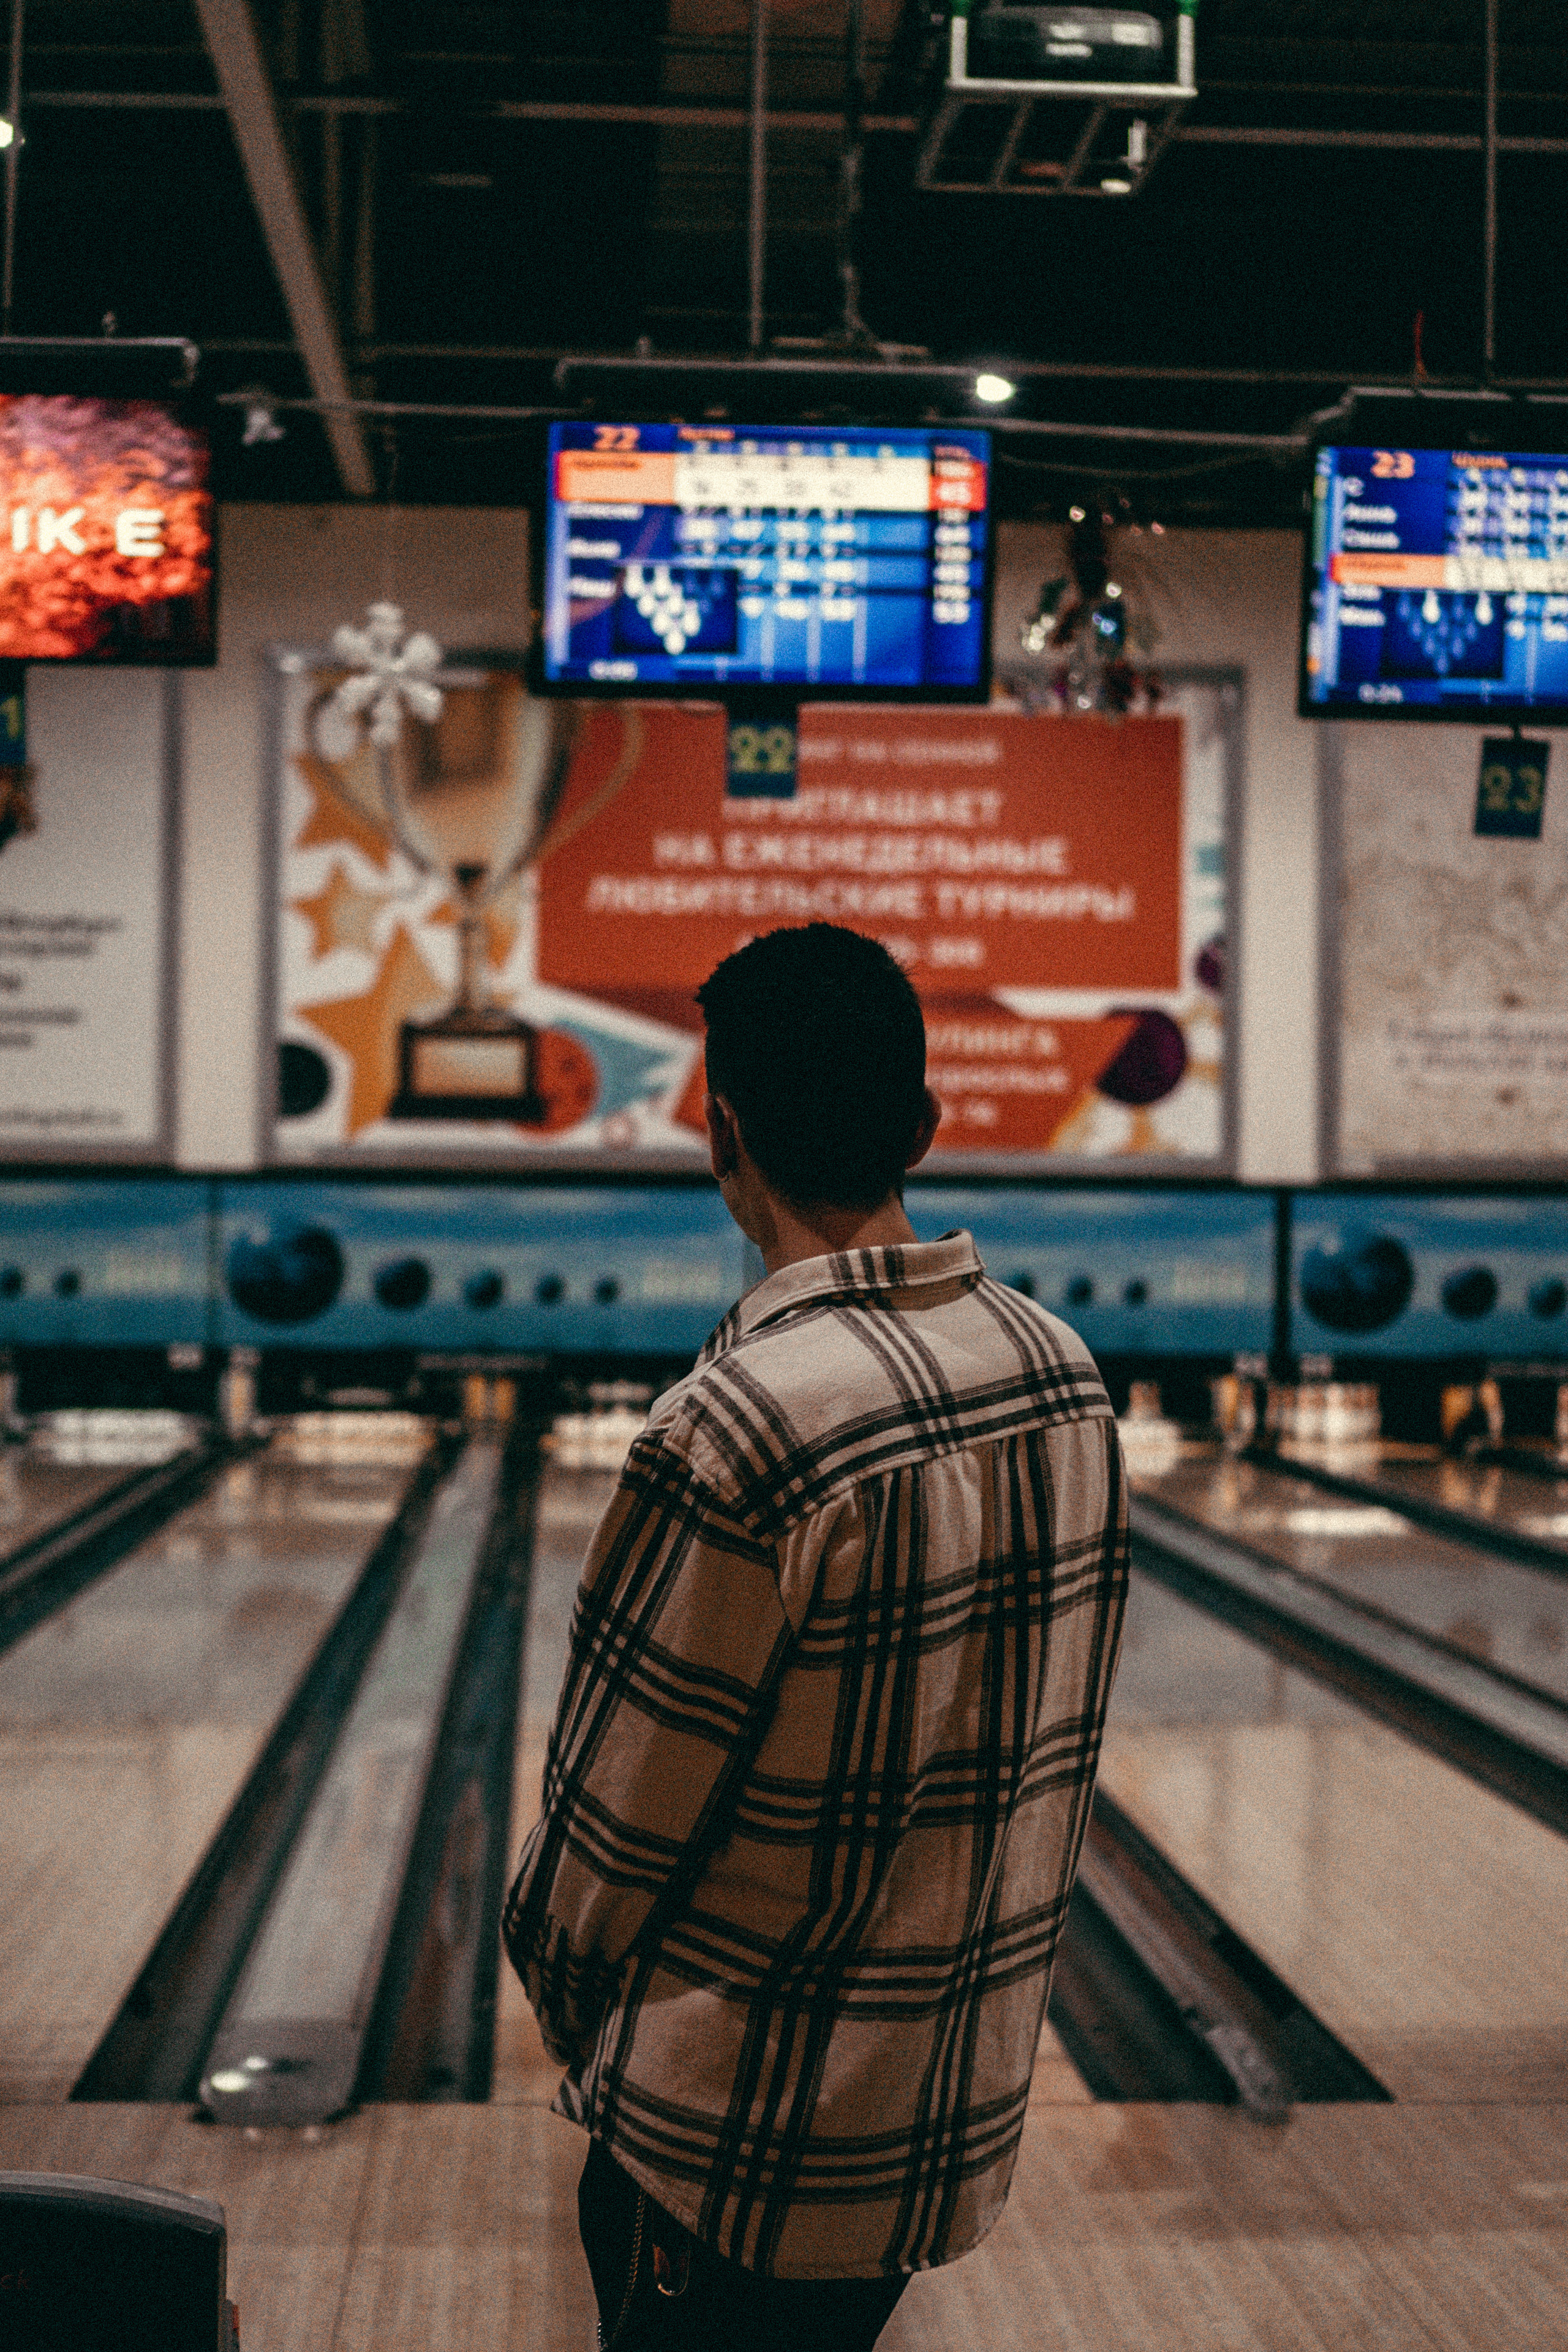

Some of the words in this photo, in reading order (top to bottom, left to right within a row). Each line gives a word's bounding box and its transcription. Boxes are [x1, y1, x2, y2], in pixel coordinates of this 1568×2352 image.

[594, 425, 641, 451] 22
[1371, 450, 1415, 478] 23
[731, 725, 795, 773] 22
[1484, 764, 1542, 814] 23
[653, 833, 717, 867] НА
[723, 834, 1068, 875] ЕЖЕНЕДЕЛЬНЫЕ
[587, 877, 925, 918] ЛЮБИТЕЛЬСКИЕ
[936, 880, 1137, 921] ТУРНИРЫ
